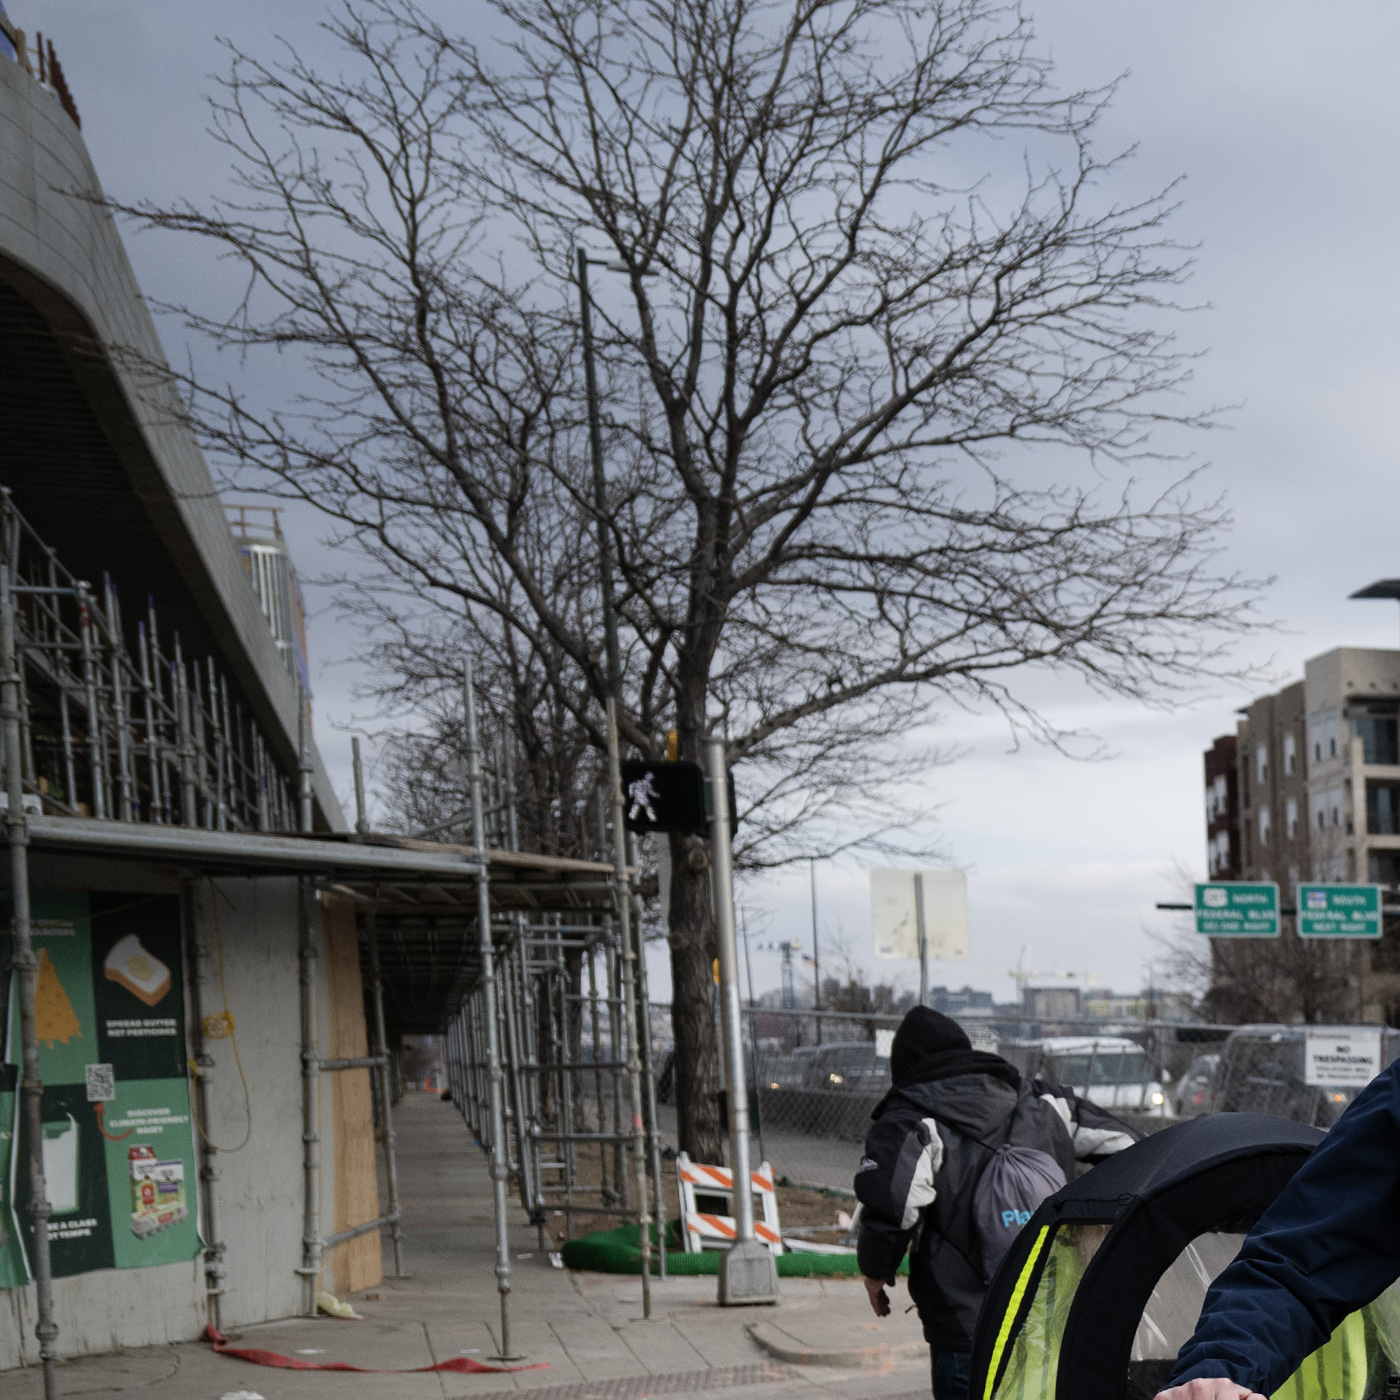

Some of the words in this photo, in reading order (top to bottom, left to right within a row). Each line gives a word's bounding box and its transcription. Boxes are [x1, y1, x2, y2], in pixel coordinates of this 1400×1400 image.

[1232, 892, 1268, 904] NORTH
[1332, 894, 1367, 906] SOUTH
[1197, 909, 1244, 921] FEDERAL
[1247, 909, 1276, 920] BLVD
[1301, 910, 1347, 922] FEDERAL
[1351, 911, 1380, 922] BLVD
[1336, 1045, 1352, 1054] NO
[1314, 1055, 1374, 1066] TRESPASSING
[1001, 1209, 1034, 1228] Pla
